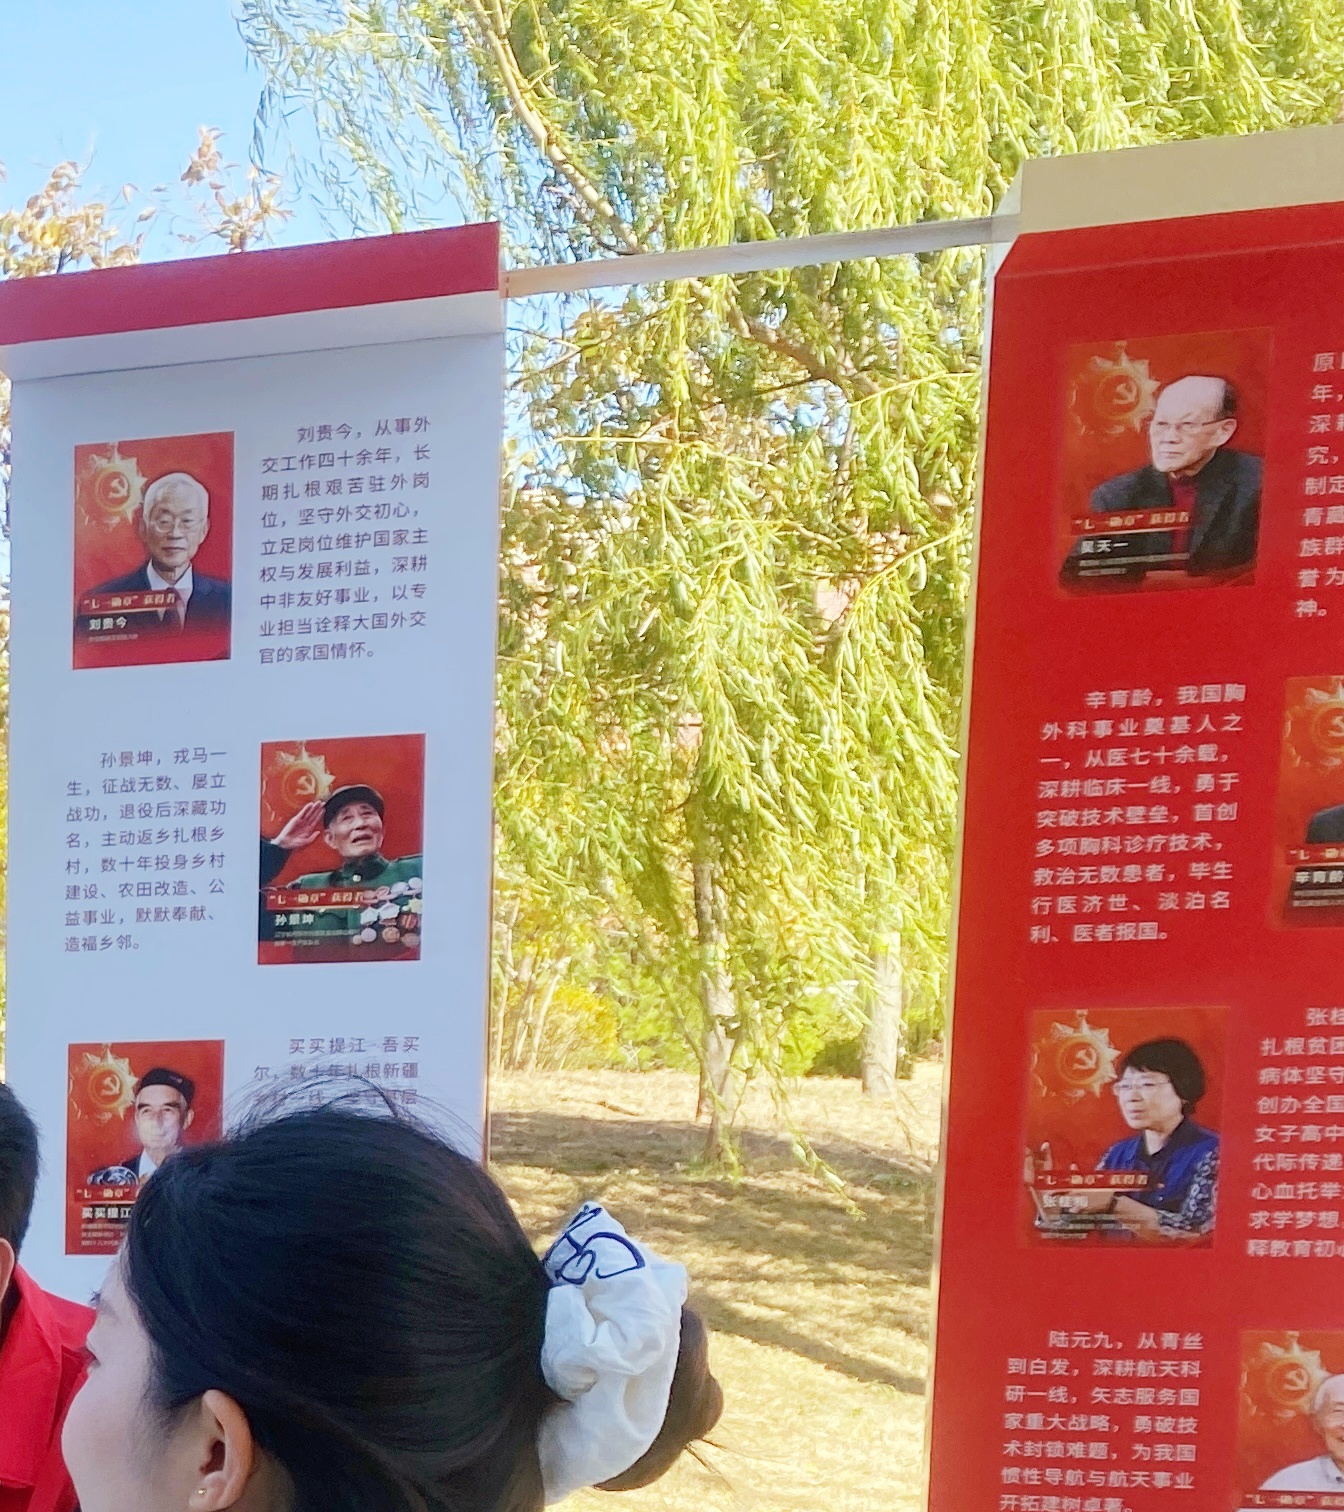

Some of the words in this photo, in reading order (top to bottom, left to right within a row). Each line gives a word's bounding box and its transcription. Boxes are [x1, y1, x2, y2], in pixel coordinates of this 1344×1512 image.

[1313, 352, 1344, 372] 原
[297, 416, 431, 444] 刘贵今，从事外
[262, 444, 431, 474] 交工作四十余年，长
[262, 472, 430, 502] 期扎根艰苦驻外岗
[262, 500, 420, 530] 位，坚守外交初心，
[261, 527, 429, 556] 立足岗位维护国家主
[260, 554, 428, 584] 权与发展利益，深耕
[260, 582, 428, 611] 中非友好事业，以专
[259, 610, 427, 638] 业担当诠释大国外交
[258, 641, 375, 664] 官的家国情怀。
[1041, 713, 1244, 742] 外科事业奠基人之
[101, 746, 228, 769] 孙景坤，戎马一
[67, 772, 227, 797] 生，征战无数、屡立
[66, 799, 227, 823] 战功，退役后深藏功
[66, 826, 225, 849] 名，主动返乡扎根乡
[66, 852, 225, 875] 村，数十年投身乡村
[65, 878, 225, 901] 建设、农田改造、公
[65, 906, 215, 927] 益事业，默默奉献、
[65, 934, 140, 953] 造福乡邻。
[1251, 1182, 1344, 1200] 心血托举
